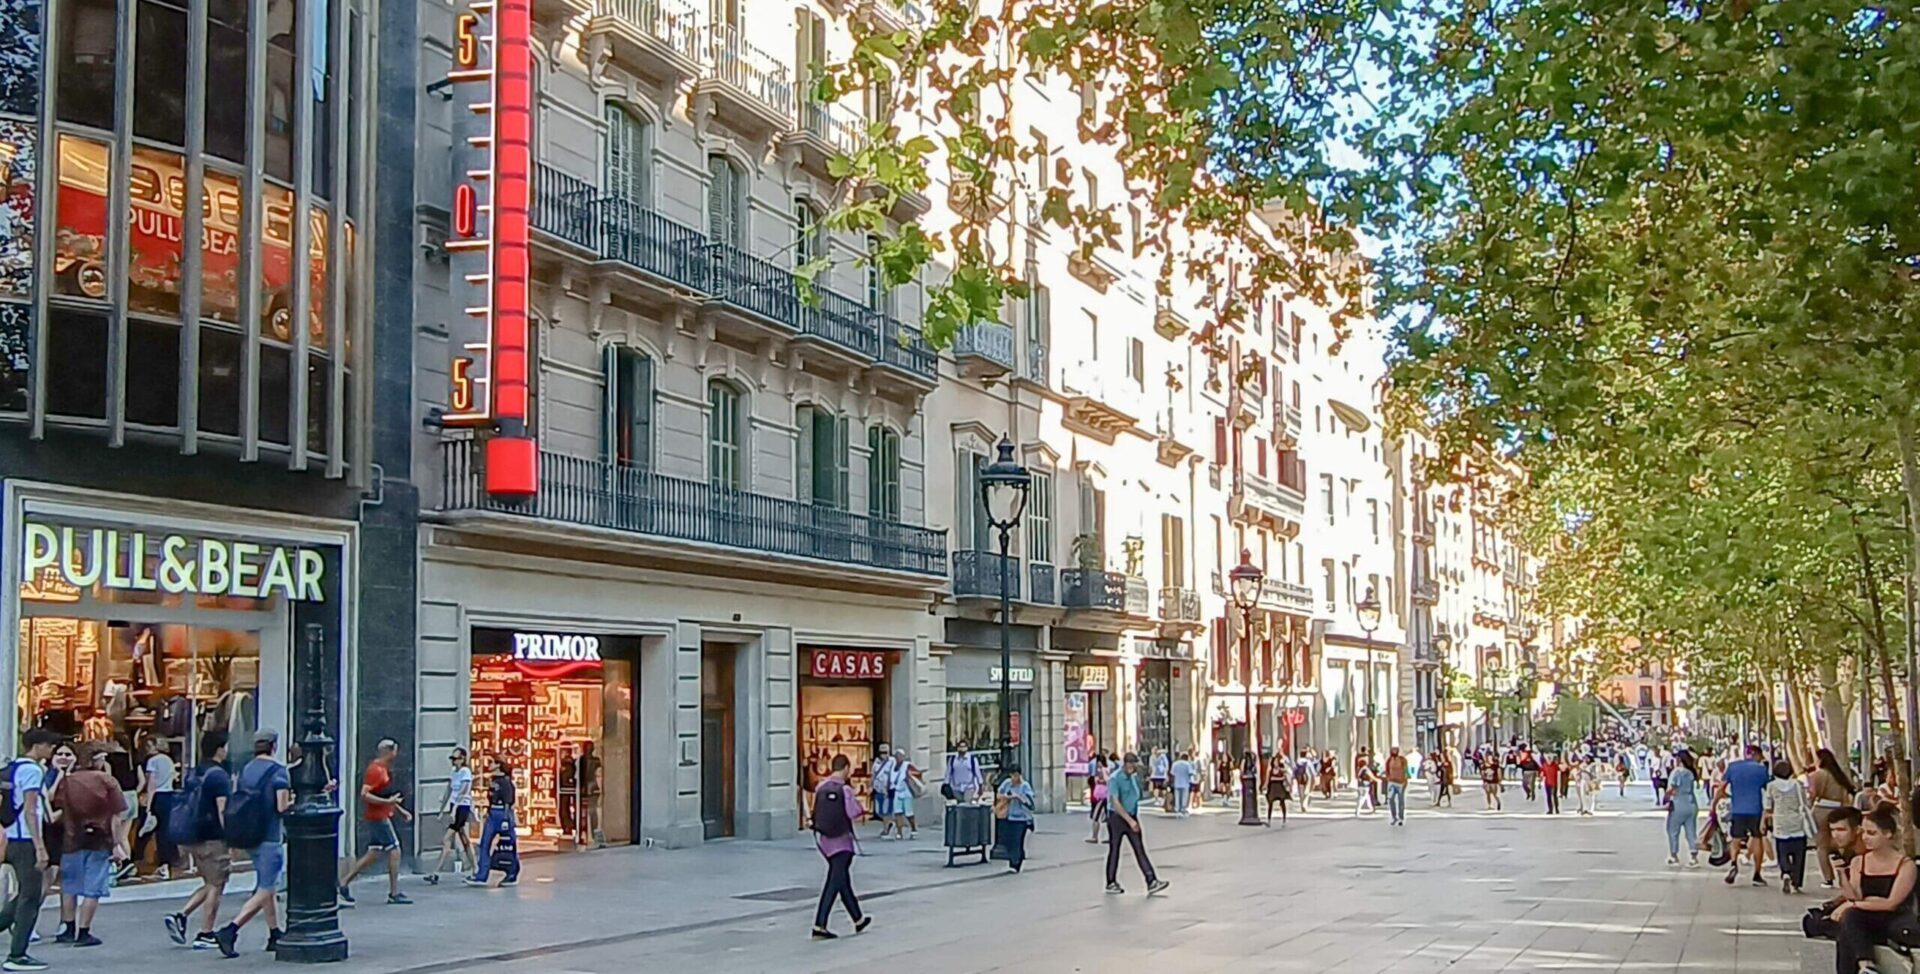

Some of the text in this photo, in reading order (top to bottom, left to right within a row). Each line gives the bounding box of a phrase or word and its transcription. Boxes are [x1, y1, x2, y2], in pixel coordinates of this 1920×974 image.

[457, 14, 476, 67] 5
[455, 183, 474, 236] 0
[453, 358, 471, 410] 5
[25, 523, 325, 603] PULL&BEAR
[514, 632, 601, 661] PRIMOR
[816, 653, 883, 674] CASAS
